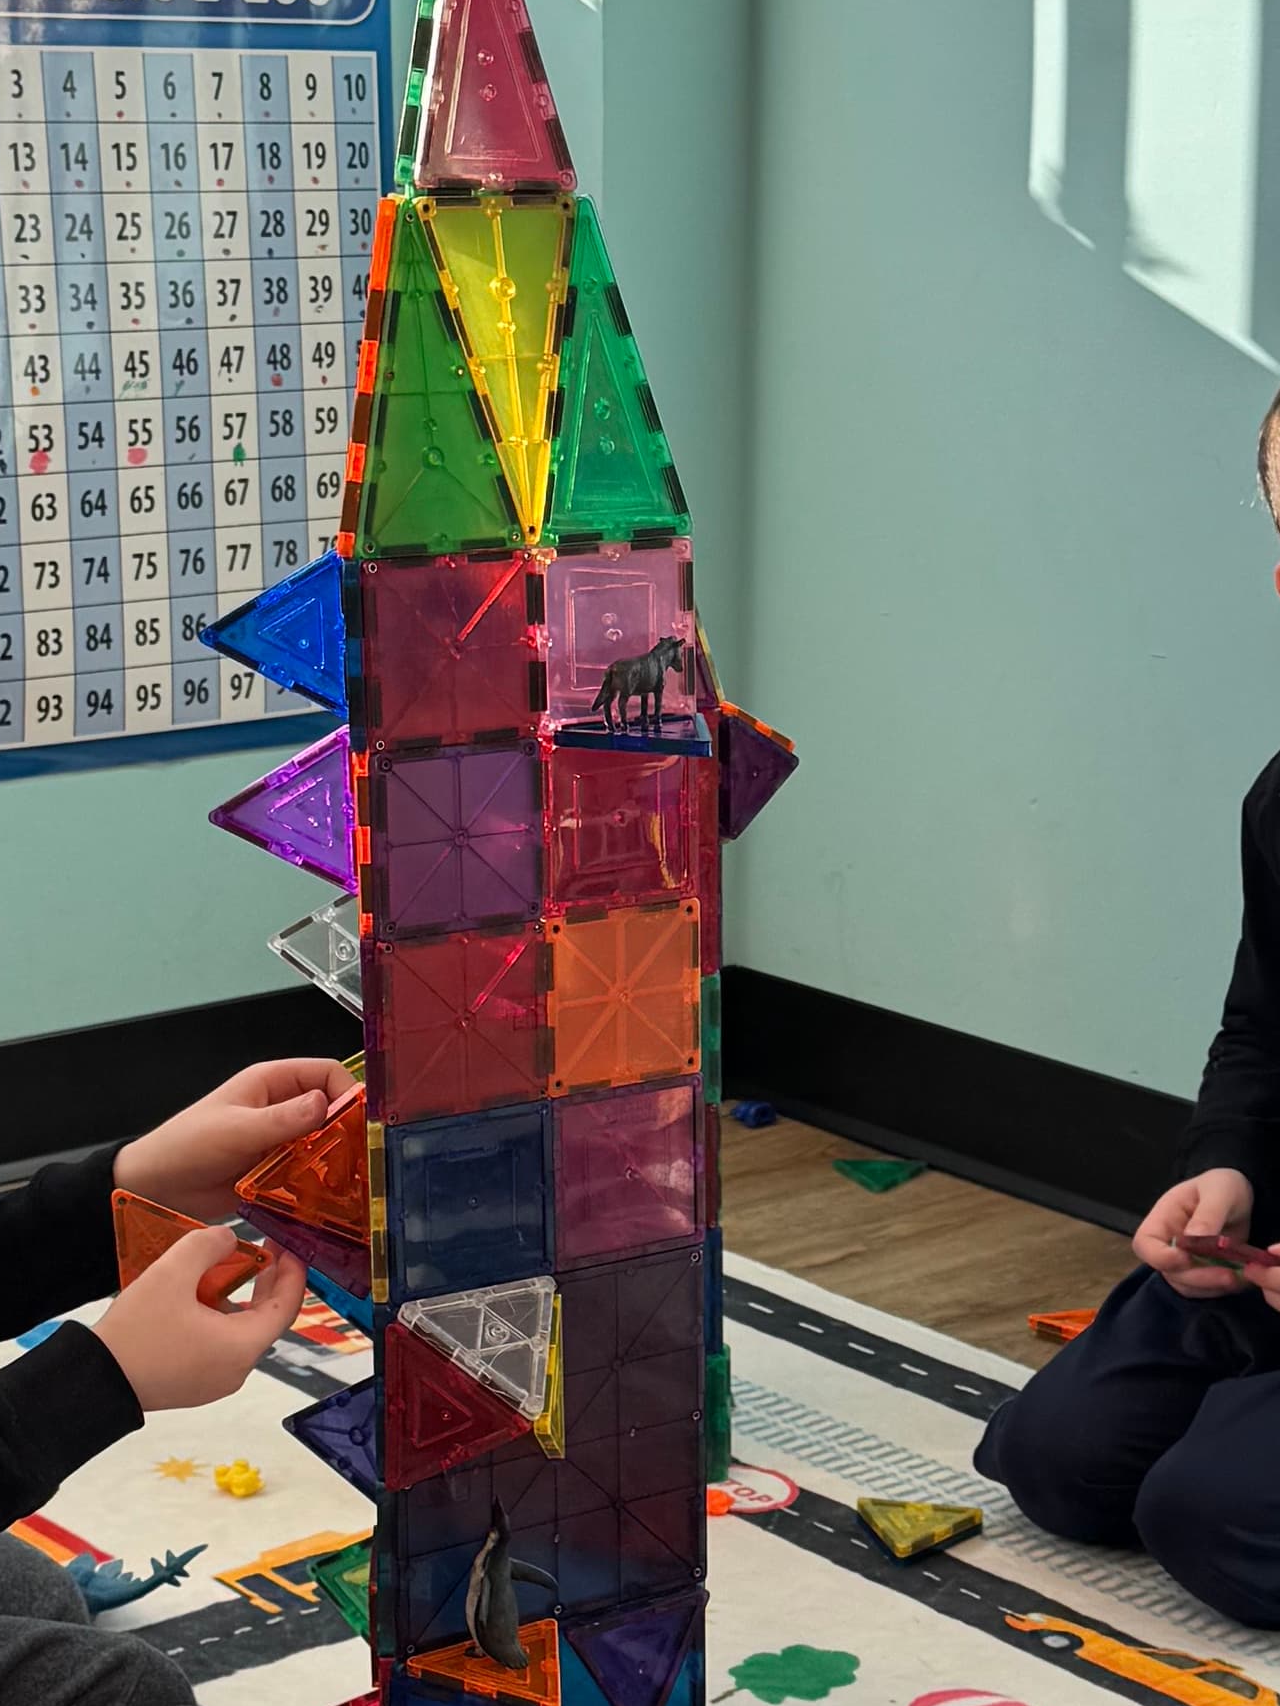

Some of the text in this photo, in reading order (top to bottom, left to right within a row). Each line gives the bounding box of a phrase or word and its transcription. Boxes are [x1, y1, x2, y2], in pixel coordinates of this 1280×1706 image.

[10, 68, 25, 99] 3
[61, 69, 78, 100] 4
[115, 70, 128, 100] 5
[163, 70, 178, 101] 6
[211, 71, 225, 101] 7
[259, 72, 274, 102] 8
[305, 72, 318, 102] 9
[343, 73, 368, 102] 10
[8, 142, 37, 172] 13
[59, 142, 90, 172] 14
[111, 142, 138, 172] 15
[159, 142, 188, 172] 16
[209, 142, 235, 171] 17
[256, 141, 283, 171] 18
[301, 141, 328, 170] 19
[346, 141, 370, 170] 20
[13, 213, 42, 244] 23
[63, 212, 96, 242] 24
[115, 212, 143, 242] 25
[163, 211, 192, 240] 26
[213, 210, 239, 240] 27
[259, 209, 287, 238] 28
[305, 208, 331, 237] 29
[349, 207, 373, 236] 30
[18, 284, 48, 314] 33
[69, 282, 100, 312] 34
[119, 281, 147, 311] 35
[168, 280, 196, 310] 36
[216, 278, 242, 307] 37
[263, 276, 290, 306] 38
[308, 274, 334, 304] 39
[23, 354, 52, 384] 43
[73, 352, 104, 382] 44
[123, 350, 151, 379] 45
[171, 348, 200, 377] 46
[219, 345, 246, 374] 47
[266, 342, 293, 372] 48
[311, 340, 337, 370] 49
[27, 424, 54, 453] 53
[77, 420, 106, 450] 54
[127, 418, 154, 448] 55
[175, 414, 202, 444] 56
[222, 412, 248, 441] 57
[269, 408, 296, 438] 58
[314, 406, 340, 435] 59
[31, 492, 59, 522] 63
[80, 488, 109, 518] 64
[129, 484, 156, 514] 65
[177, 481, 204, 510] 66
[224, 477, 250, 507] 67
[270, 474, 298, 503] 68
[316, 470, 342, 499] 69
[33, 560, 62, 590] 73
[82, 556, 112, 586] 74
[131, 551, 159, 582] 75
[179, 546, 207, 576] 76
[225, 542, 253, 572] 77
[272, 538, 299, 568] 78
[36, 627, 64, 658] 83
[85, 622, 114, 652] 84
[135, 617, 162, 647] 85
[36, 694, 64, 724] 93
[86, 688, 115, 718] 94
[135, 682, 162, 712] 95
[183, 677, 210, 706] 96
[229, 671, 256, 701] 97
